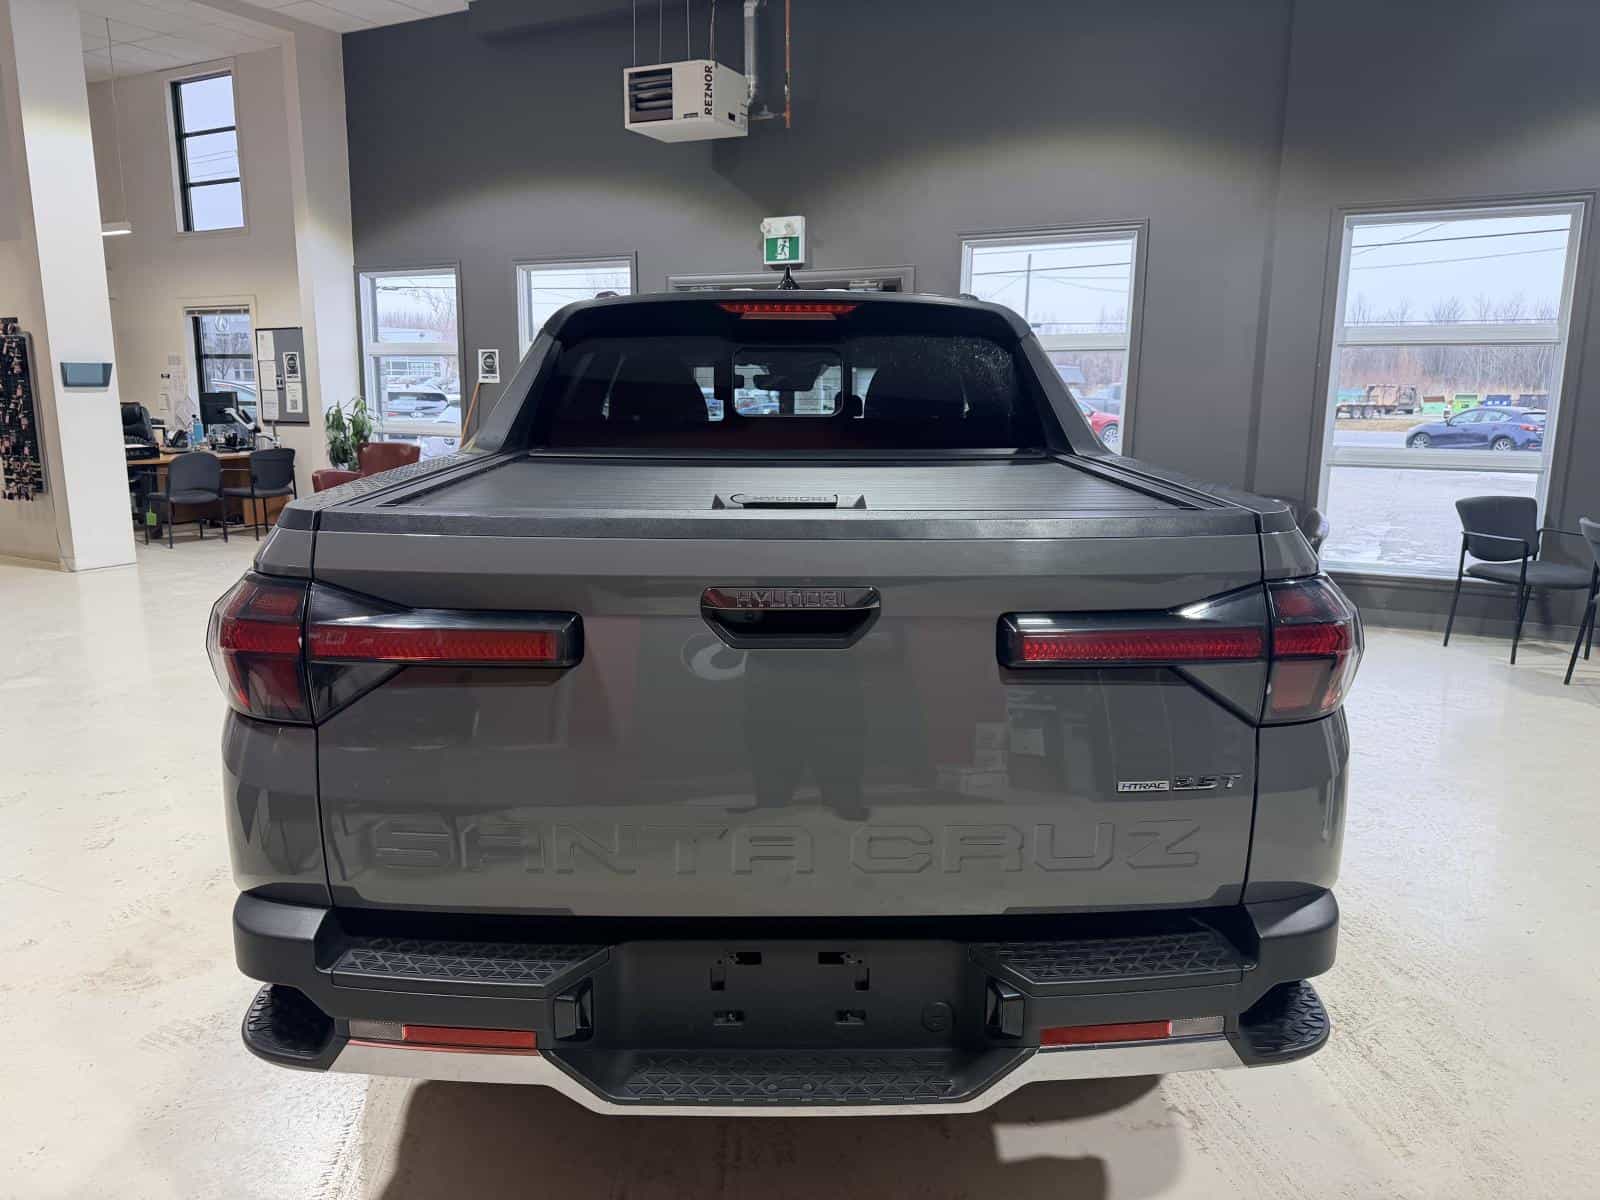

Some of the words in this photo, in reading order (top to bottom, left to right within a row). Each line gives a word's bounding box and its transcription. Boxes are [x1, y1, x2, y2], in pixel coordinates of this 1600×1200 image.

[704, 65, 713, 116] REZNOR
[736, 591, 847, 608] HYUNDAI
[1119, 782, 1169, 791] HTRAC
[370, 822, 815, 874] SANTA
[850, 819, 1201, 874] CRUZ
